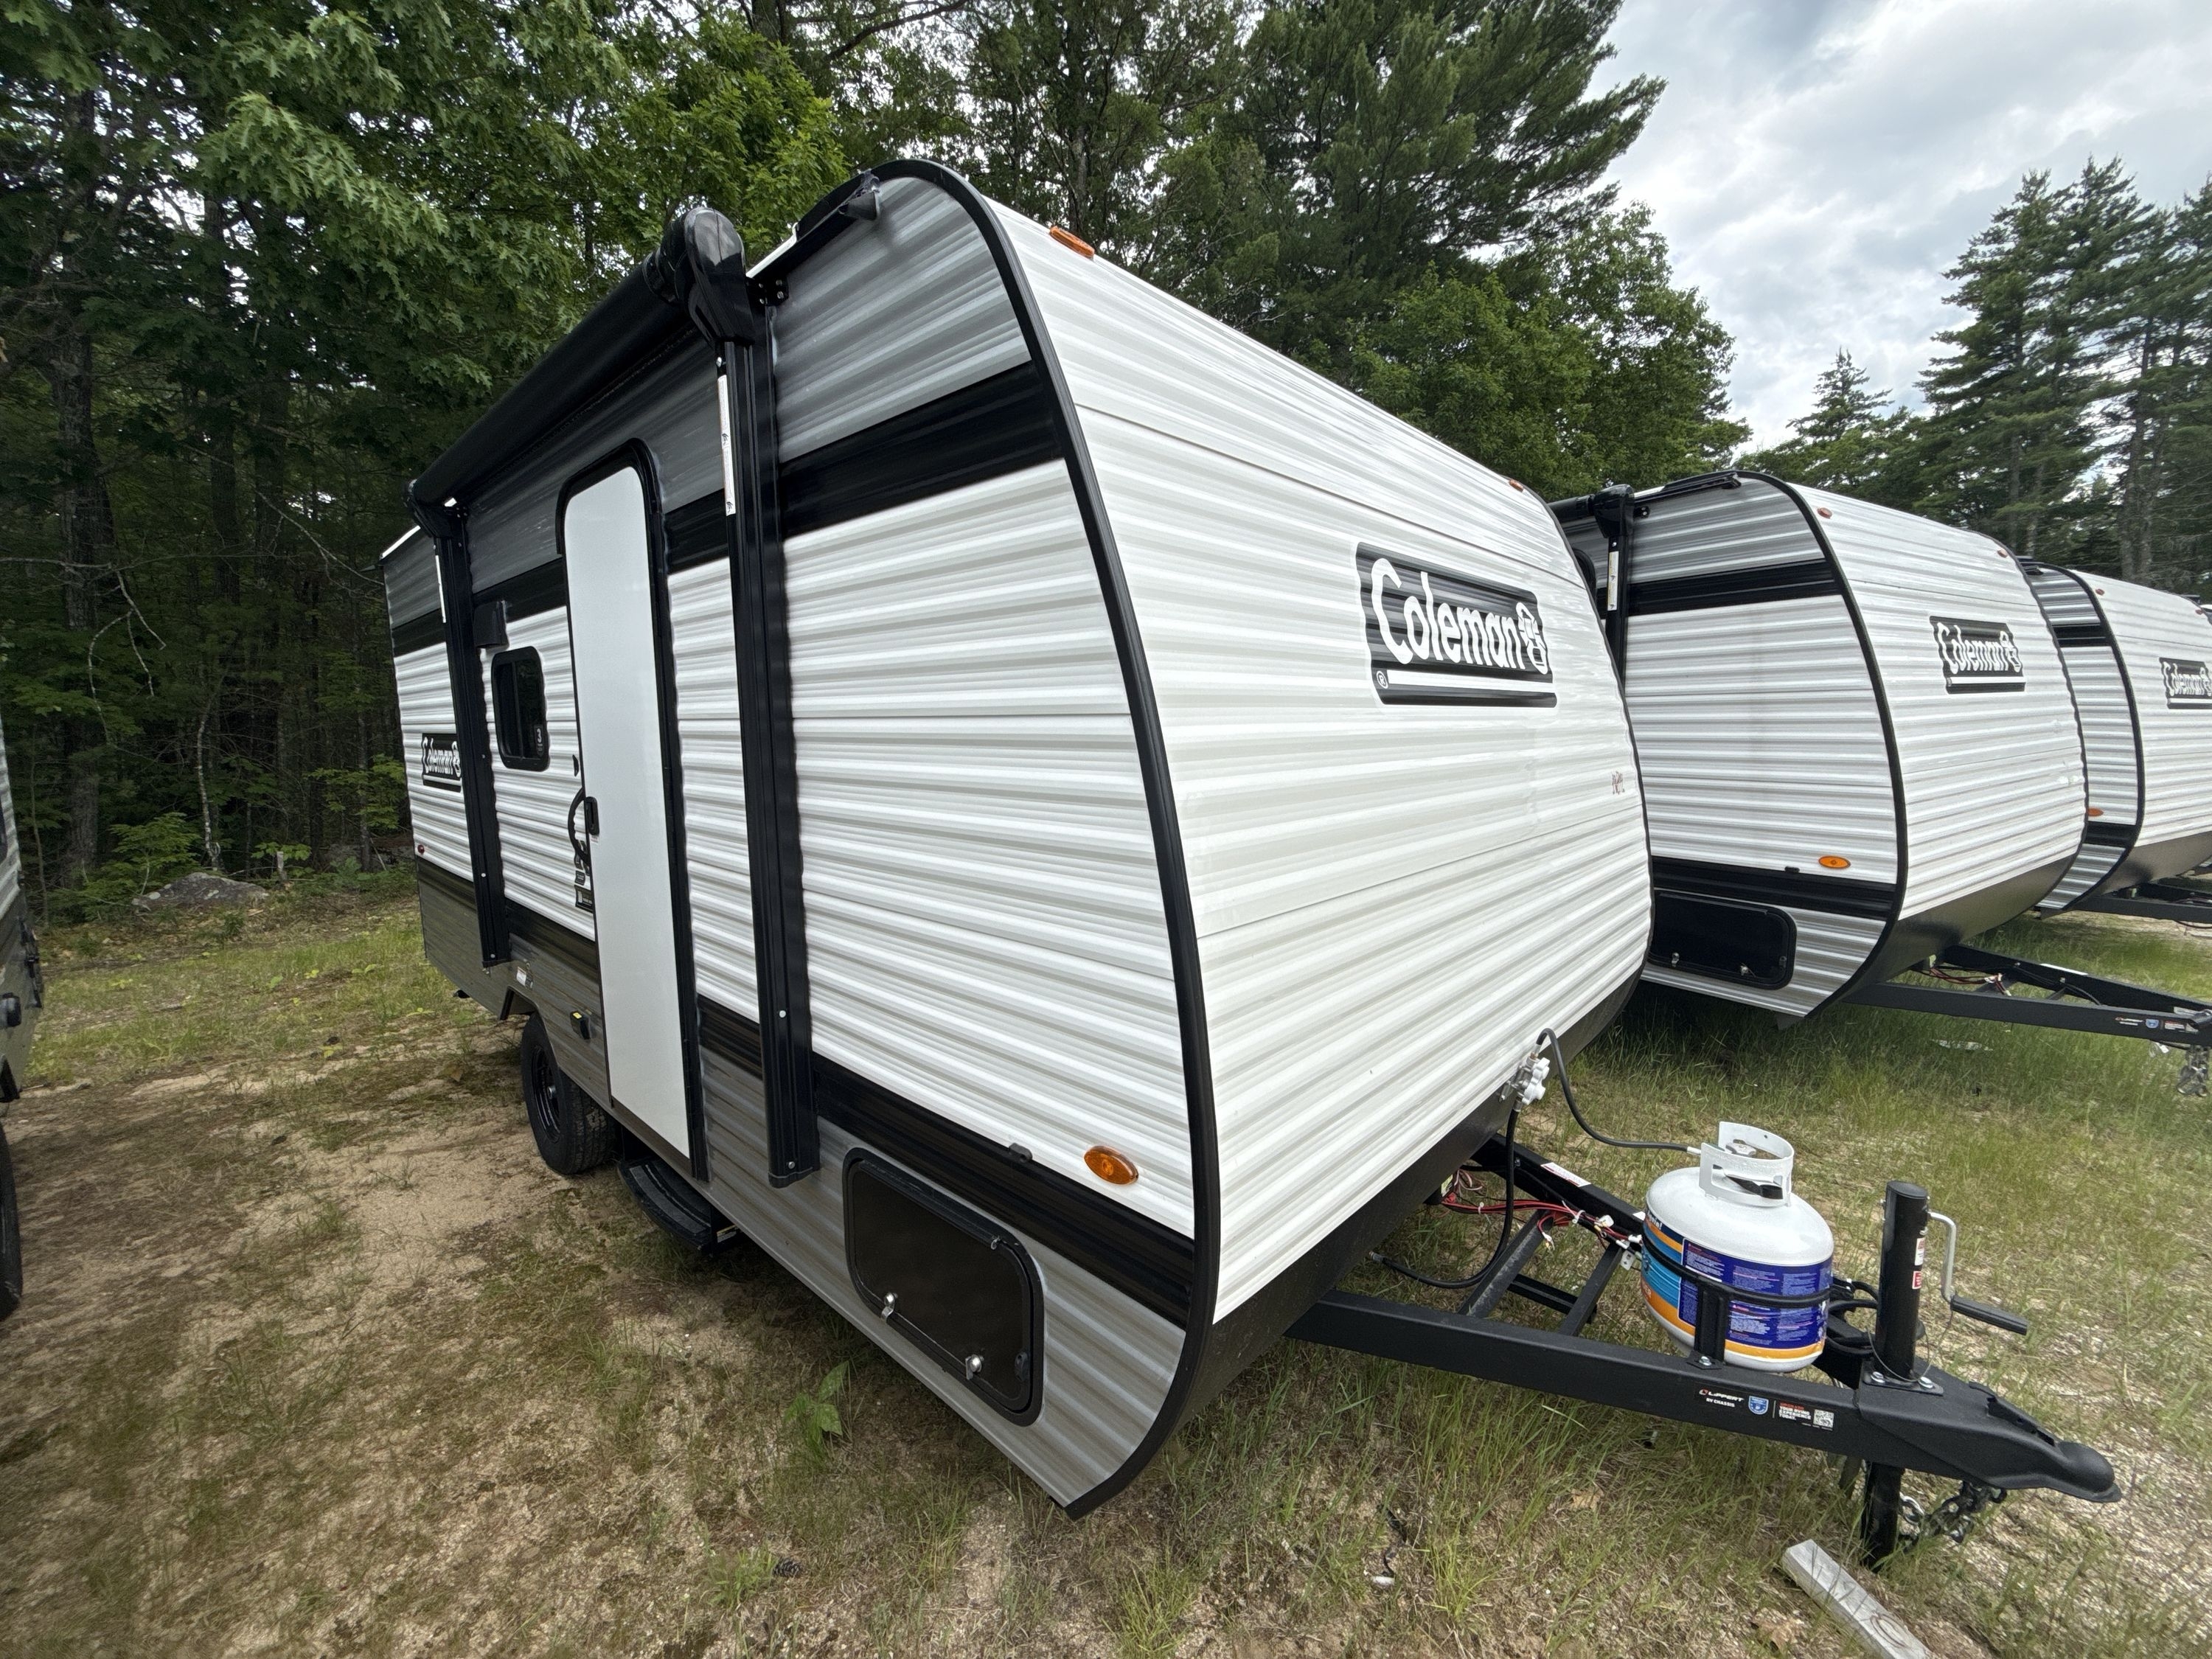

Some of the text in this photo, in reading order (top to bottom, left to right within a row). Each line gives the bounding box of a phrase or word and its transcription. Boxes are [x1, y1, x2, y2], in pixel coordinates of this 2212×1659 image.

[1371, 557, 1526, 670] Coleman
[1936, 622, 2009, 675] Coleman
[2163, 661, 2205, 697] Coleman
[422, 737, 453, 776] Coleman
[1714, 1398, 1736, 1408] CHASSIS
